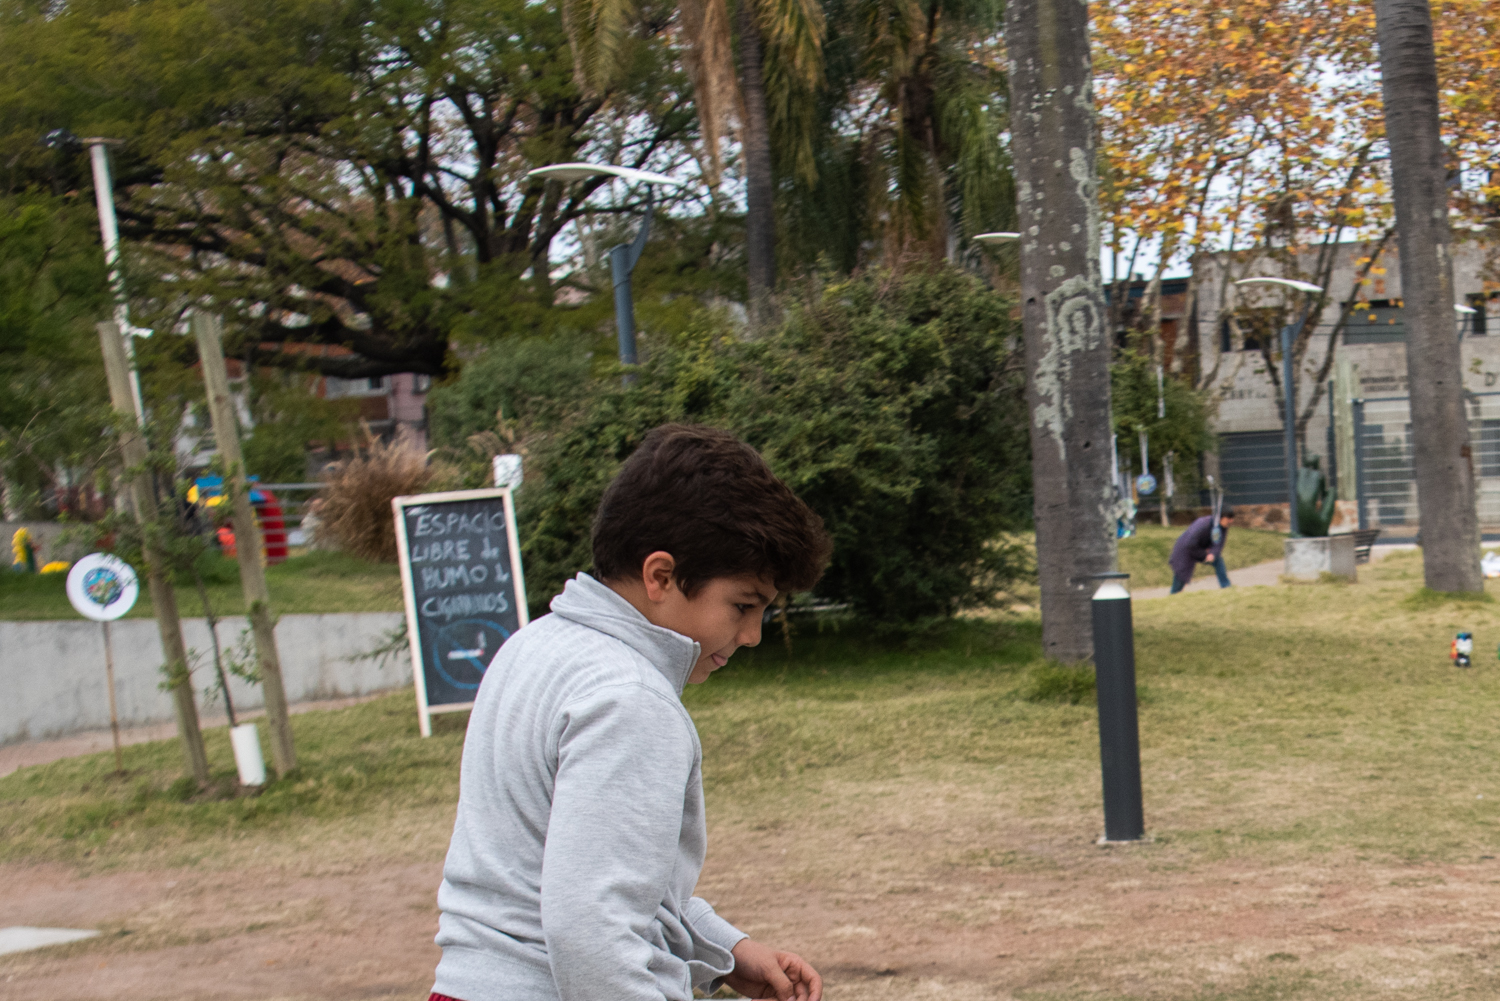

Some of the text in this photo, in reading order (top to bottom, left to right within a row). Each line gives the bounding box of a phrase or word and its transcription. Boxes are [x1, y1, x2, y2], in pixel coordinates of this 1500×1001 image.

[415, 509, 506, 537] ESPACIO
[411, 540, 471, 562] LIBRE
[421, 564, 488, 591] HUMO
